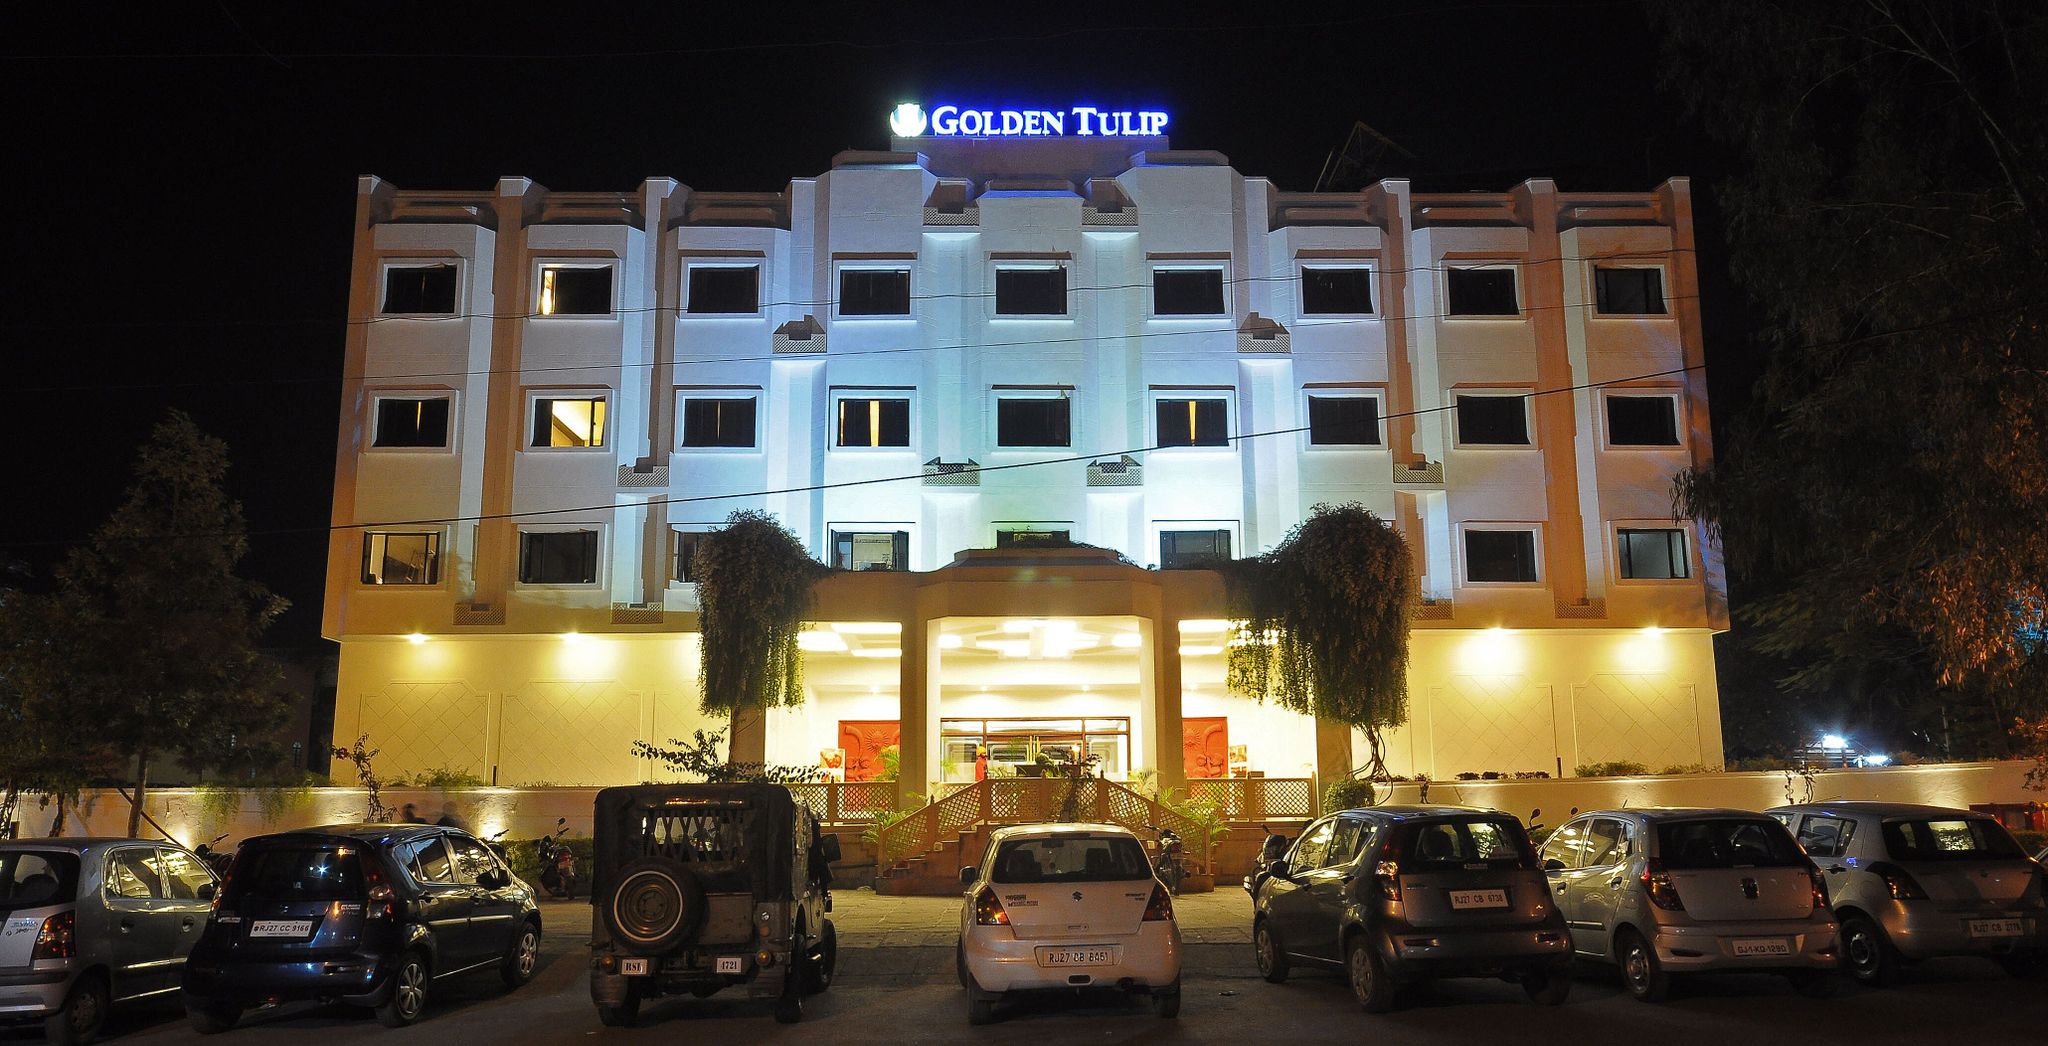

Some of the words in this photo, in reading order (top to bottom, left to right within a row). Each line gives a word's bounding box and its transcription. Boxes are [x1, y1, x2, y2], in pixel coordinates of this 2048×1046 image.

[930, 105, 1065, 137] GOLDEN
[1071, 106, 1169, 136] TULIP
[259, 924, 279, 932] RJ27
[279, 924, 291, 932] CC
[292, 924, 310, 932] 9166
[1049, 952, 1071, 963] RJ27
